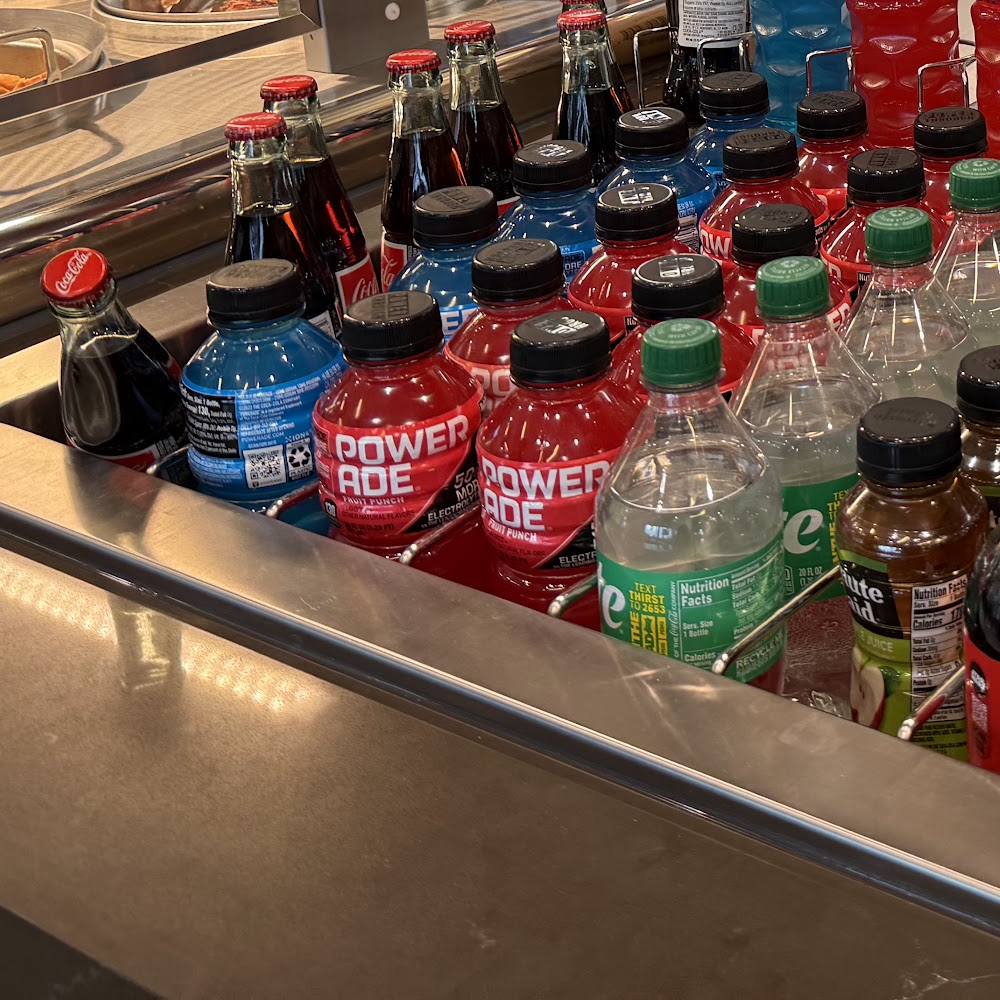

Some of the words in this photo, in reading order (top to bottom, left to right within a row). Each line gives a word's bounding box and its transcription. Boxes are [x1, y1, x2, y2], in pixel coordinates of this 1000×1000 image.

[55, 250, 90, 295] Coca-Cola
[335, 414, 469, 465] POWER
[338, 463, 414, 496] ADE
[482, 456, 610, 500] POWER
[342, 496, 367, 505] FRUIT
[370, 497, 404, 505] PUNCH
[484, 488, 545, 531] ADE
[488, 518, 506, 535] FRUIT
[507, 528, 538, 542] PUNCH
[807, 568, 814, 576] FL
[634, 582, 657, 593] TEXT
[681, 577, 730, 595] Nutrition
[732, 581, 745, 590] Total
[914, 586, 947, 600] Nutrition
[949, 578, 967, 594] Facts
[629, 590, 665, 604] THIRST
[682, 594, 712, 607] Facts
[732, 599, 746, 608] Total
[630, 599, 641, 611] TO
[642, 603, 666, 615] 2653
[682, 621, 698, 630] Serv.
[913, 617, 943, 630] Calories
[689, 629, 709, 637] Bottle
[867, 634, 894, 653] JUICE
[684, 652, 716, 662] Calories
[736, 641, 772, 668] RECYCLE
